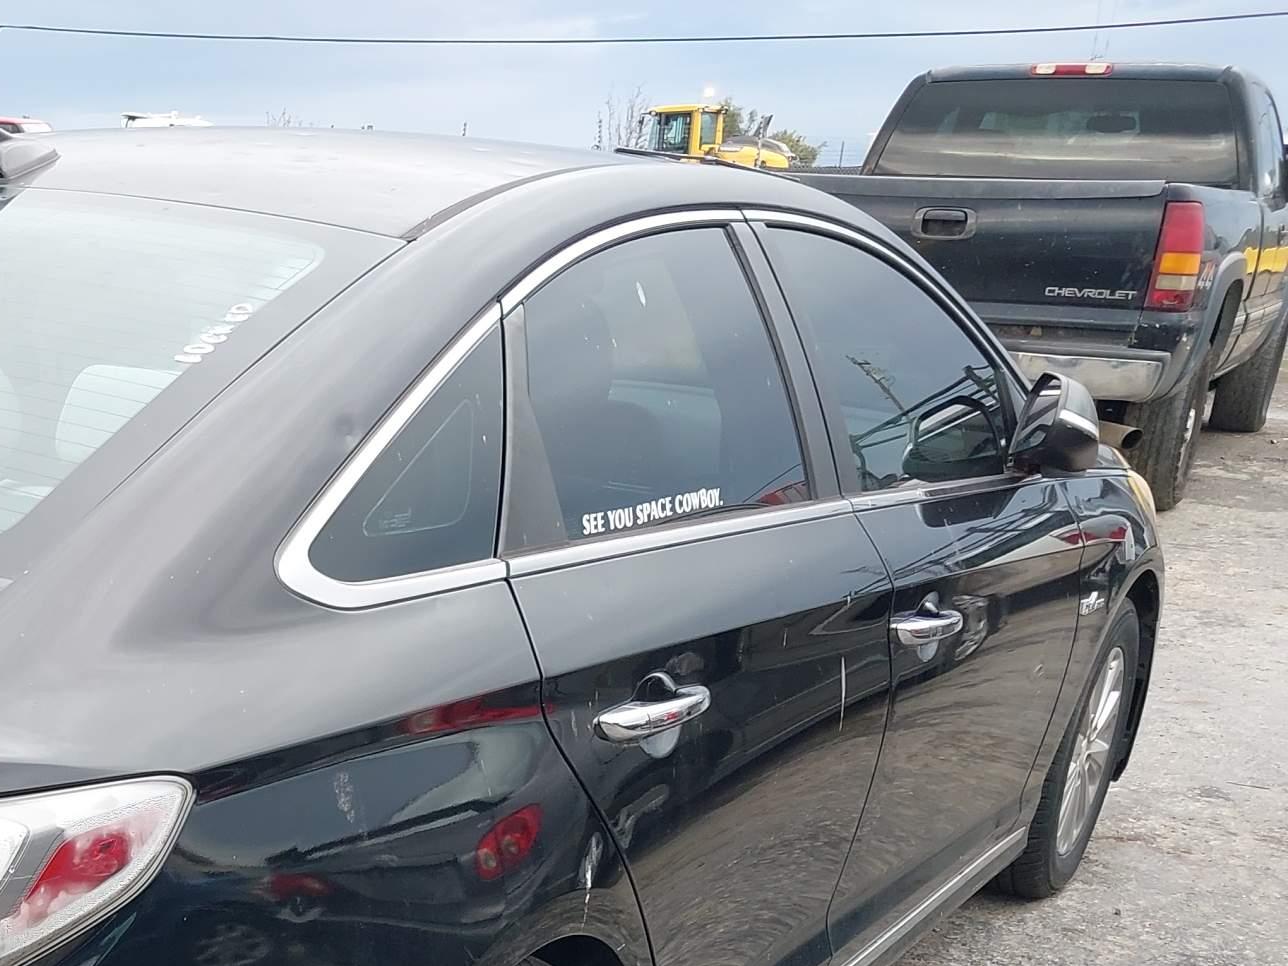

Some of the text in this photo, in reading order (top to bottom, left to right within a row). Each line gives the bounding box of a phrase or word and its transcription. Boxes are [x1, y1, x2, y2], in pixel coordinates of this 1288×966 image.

[1045, 286, 1137, 300] CHEVROLET
[582, 511, 606, 535] SEE
[607, 507, 634, 530] YOU
[636, 497, 673, 525] SPACE
